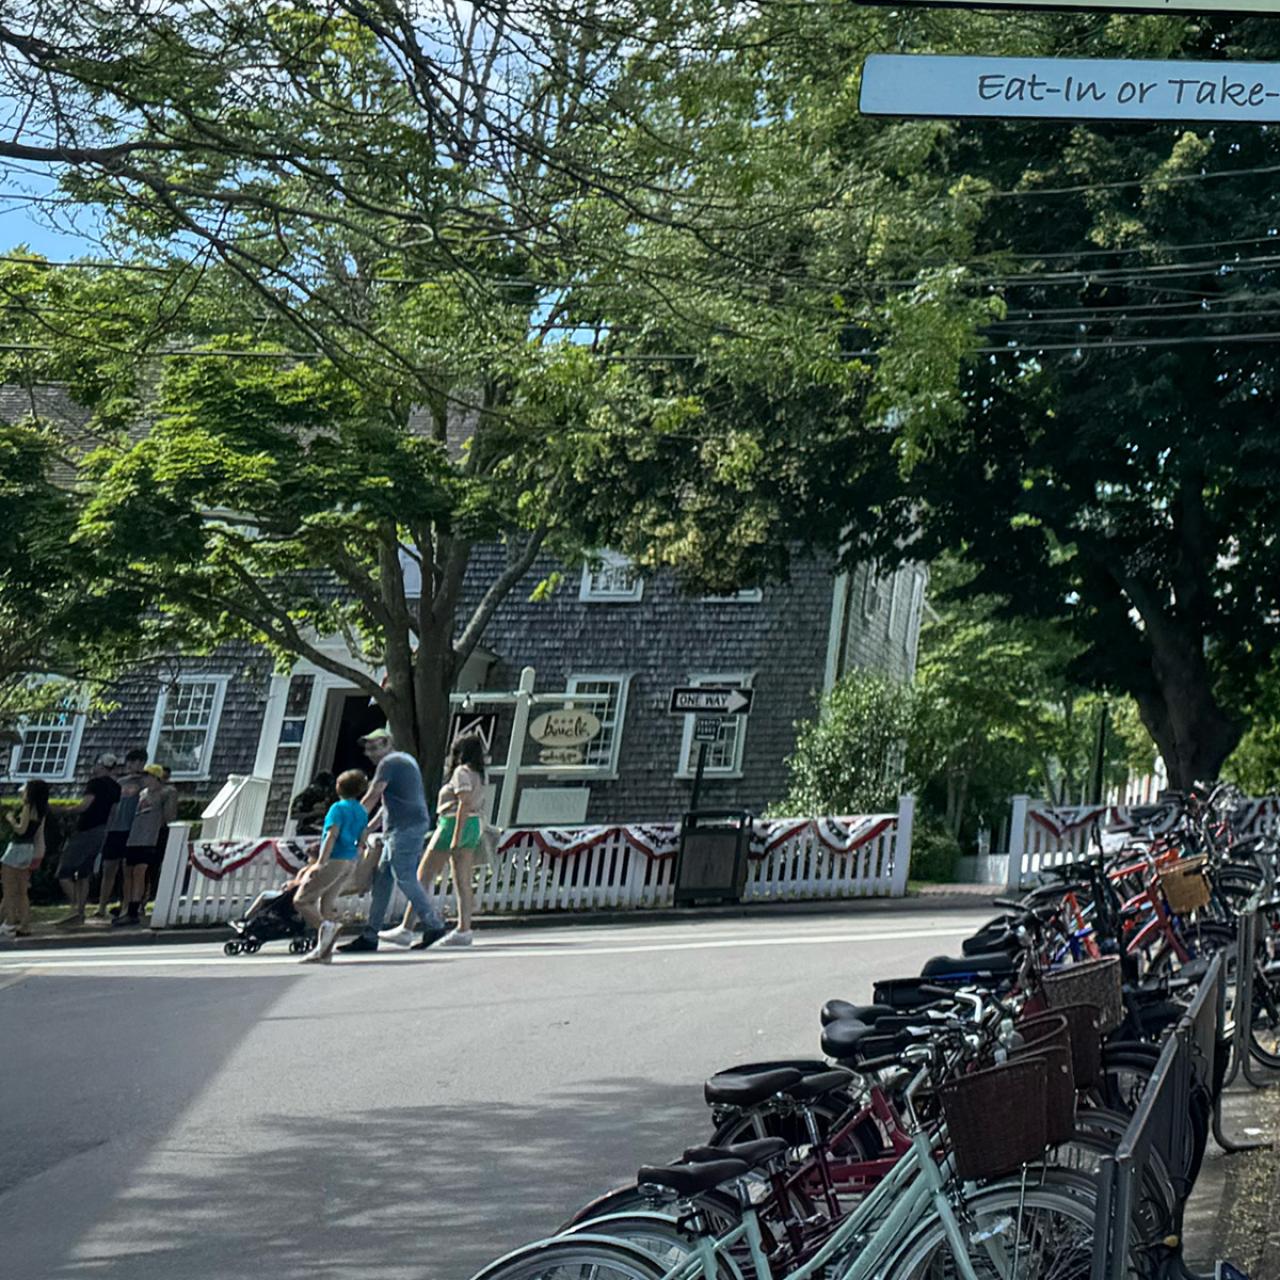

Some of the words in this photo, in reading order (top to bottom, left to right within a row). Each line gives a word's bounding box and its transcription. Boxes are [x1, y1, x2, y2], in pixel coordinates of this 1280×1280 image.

[977, 74, 1106, 105] Eat-In
[1117, 81, 1154, 105] or
[680, 694, 703, 707] ONE
[705, 695, 729, 708] WAY
